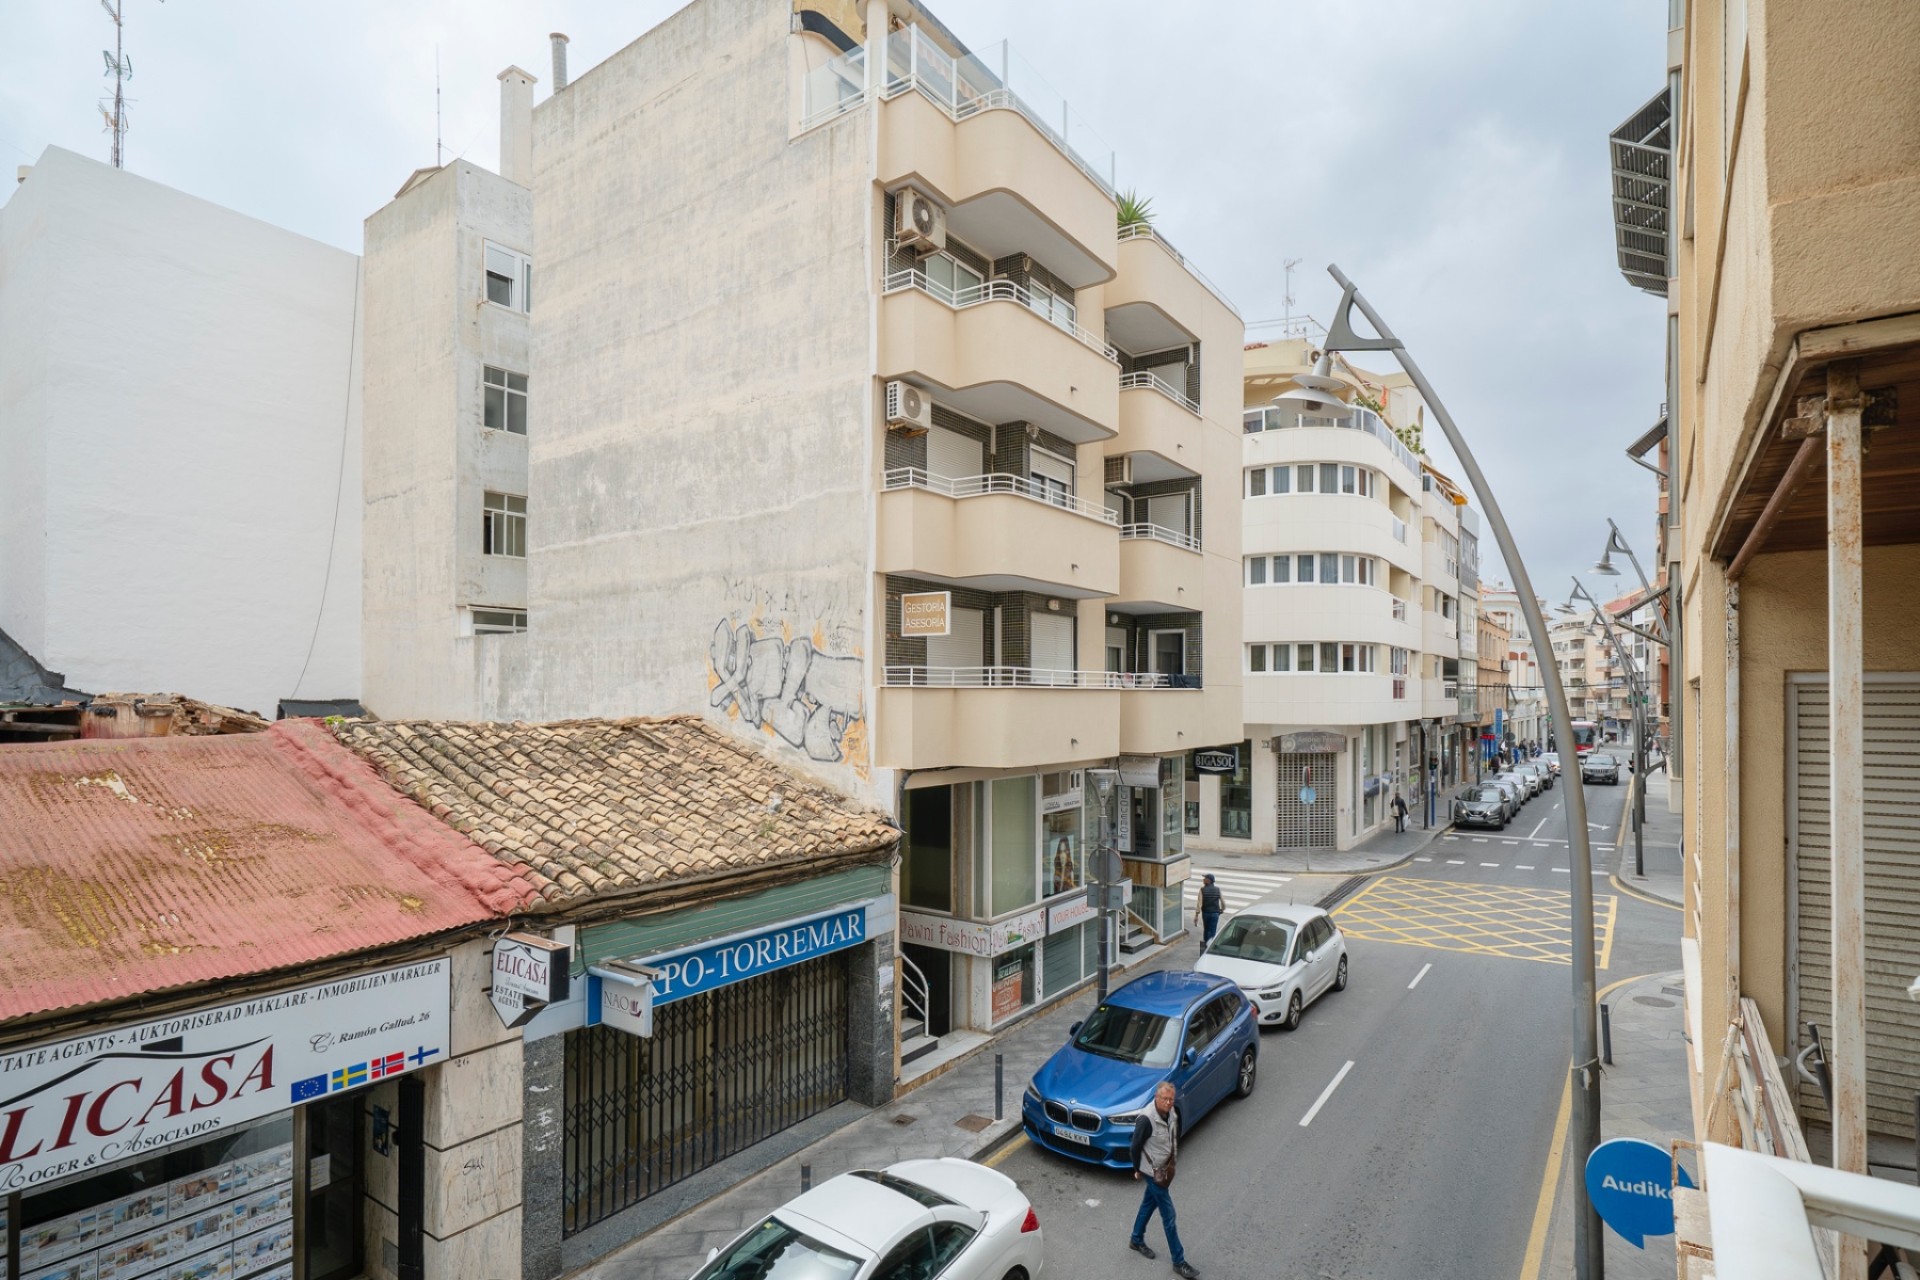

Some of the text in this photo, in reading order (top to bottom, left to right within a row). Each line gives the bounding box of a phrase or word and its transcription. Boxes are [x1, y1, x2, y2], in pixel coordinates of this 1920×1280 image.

[1195, 753, 1235, 768] BIGASOL
[939, 921, 987, 952] Fashion
[496, 951, 547, 986] ELICASA
[494, 984, 522, 1002] ESTATE
[498, 995, 519, 1009] AGENTS
[604, 991, 630, 1011] NAO
[0, 1049, 47, 1073] TATE
[49, 1034, 115, 1062] AGENTS
[128, 1007, 242, 1044] AUKTORISERAD
[244, 991, 308, 1018] MÄKLARE
[317, 973, 387, 1001] INMOBILIEN
[389, 962, 441, 983] MARKLER
[339, 1025, 377, 1043] Ramón
[418, 1011, 431, 1022] 26
[0, 1043, 275, 1165] LICASA
[84, 1153, 97, 1166] &
